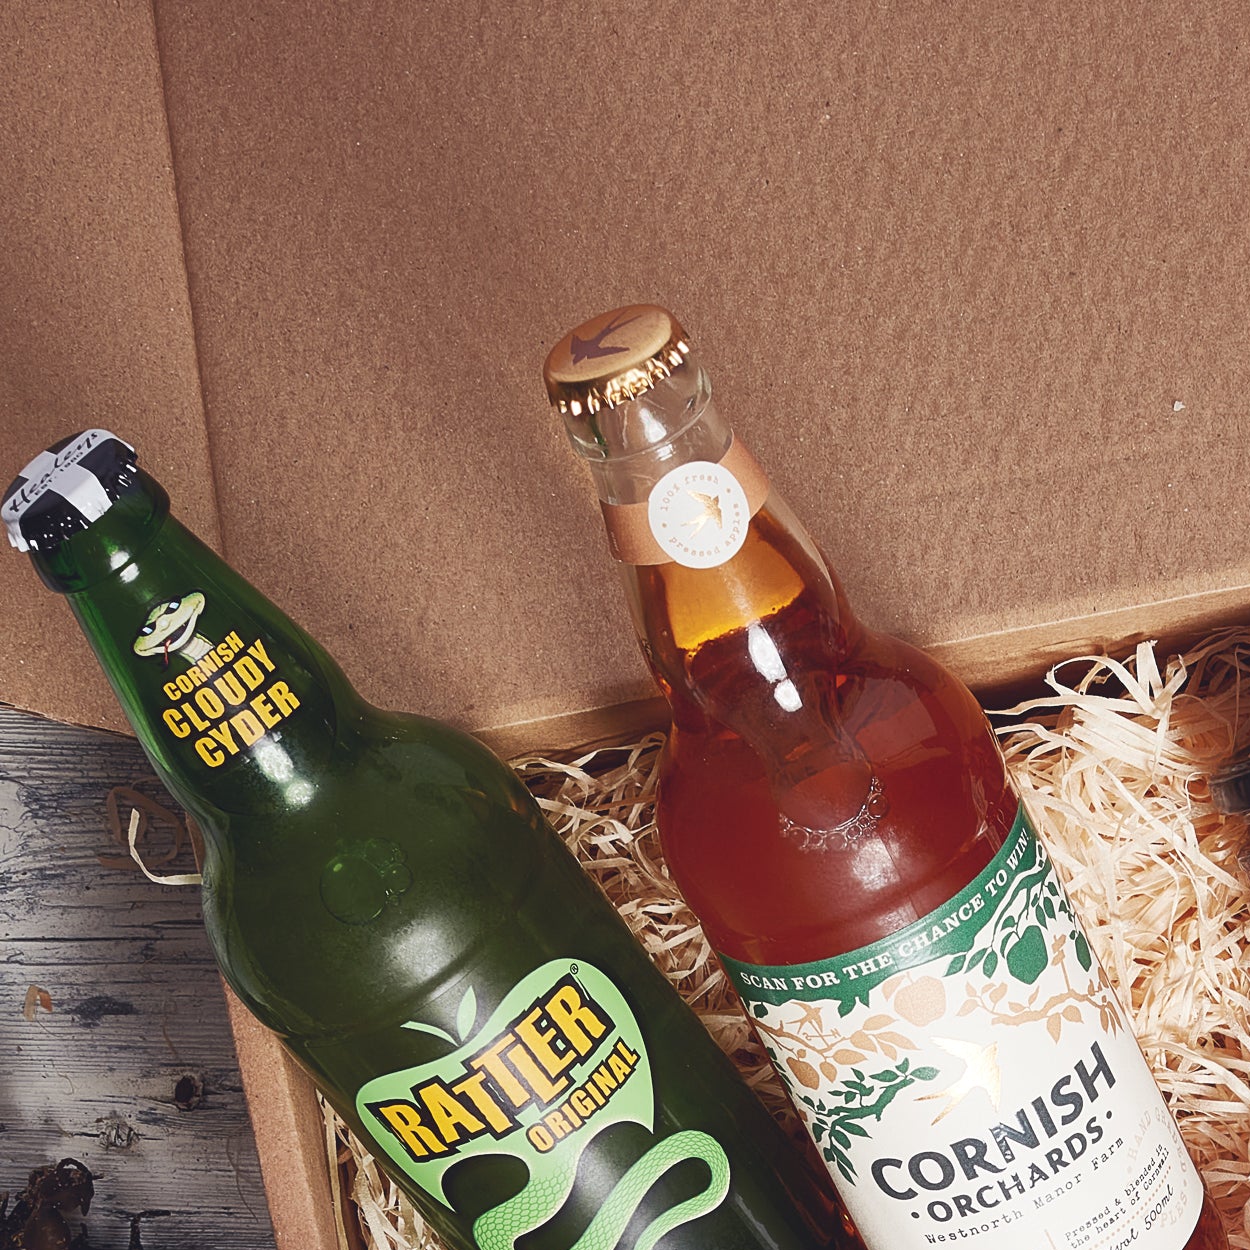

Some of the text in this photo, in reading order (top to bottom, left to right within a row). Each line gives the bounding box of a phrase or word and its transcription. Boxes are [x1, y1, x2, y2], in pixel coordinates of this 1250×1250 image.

[668, 502, 741, 557] pressed apples
[162, 638, 277, 740] CLOUDY
[163, 630, 245, 702] CORNISH
[194, 680, 301, 769] CYDER
[740, 827, 1032, 992] SCAN FOR THE CHANCE TO WIN!
[376, 980, 610, 1160] RATTLER
[526, 1042, 640, 1154] ORIGINAL
[870, 1040, 1117, 1201] CORNISH
[925, 1136, 1124, 1245] Westnorth Manor Farm
[926, 1117, 1105, 1223] ORCHARDS
[1065, 1205, 1112, 1242] Pressed
[1124, 1155, 1156, 1197] blended
[1155, 1143, 1164, 1157] in
[1070, 1147, 1170, 1250] the heart of Cornwall
[1144, 1183, 1175, 1231] 500ml
